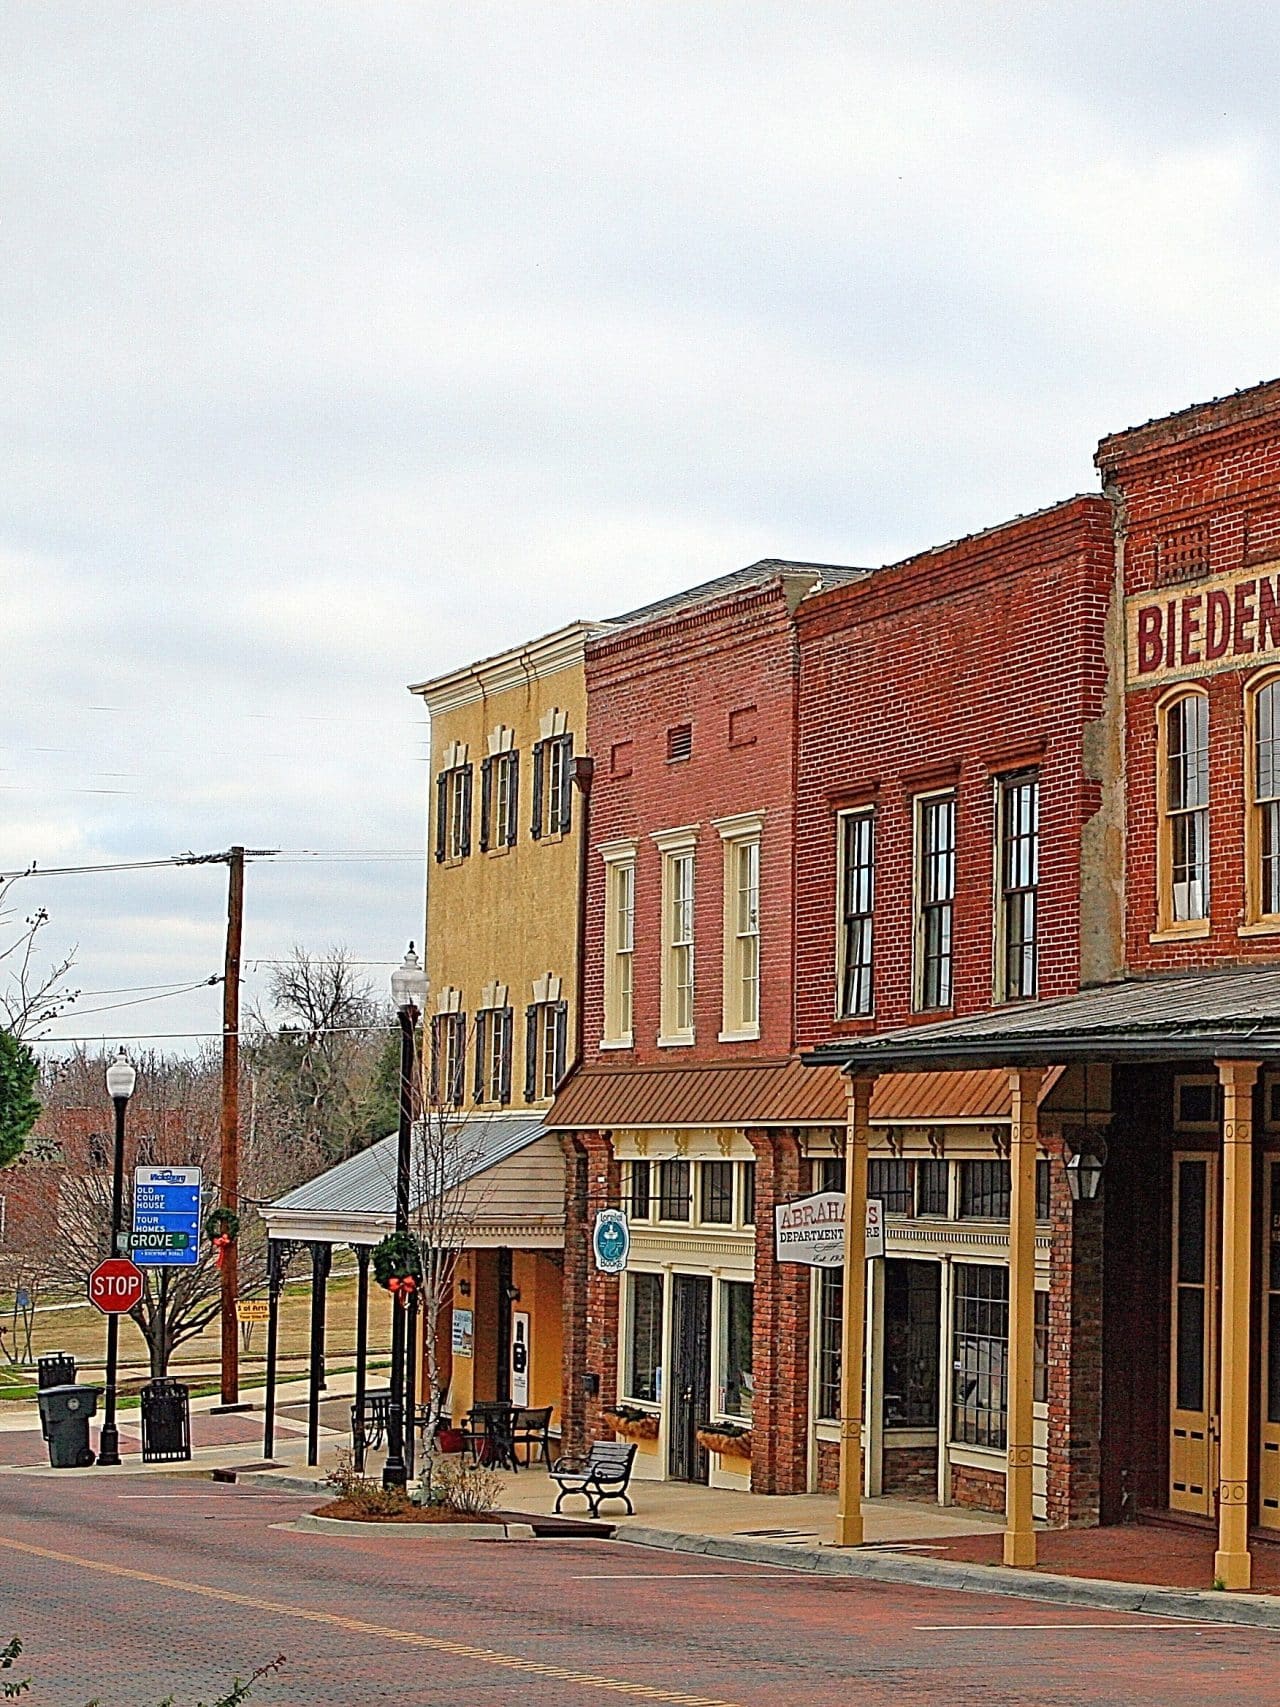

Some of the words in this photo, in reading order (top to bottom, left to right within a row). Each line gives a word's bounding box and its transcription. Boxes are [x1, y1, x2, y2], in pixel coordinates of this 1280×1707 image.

[137, 1194, 165, 1202] COURT
[136, 1216, 159, 1224] TOUR
[136, 1225, 166, 1233] HOMES
[130, 1234, 173, 1247] GROVE
[780, 1229, 844, 1243] DEPARTMENT
[94, 1276, 139, 1296] STOP
